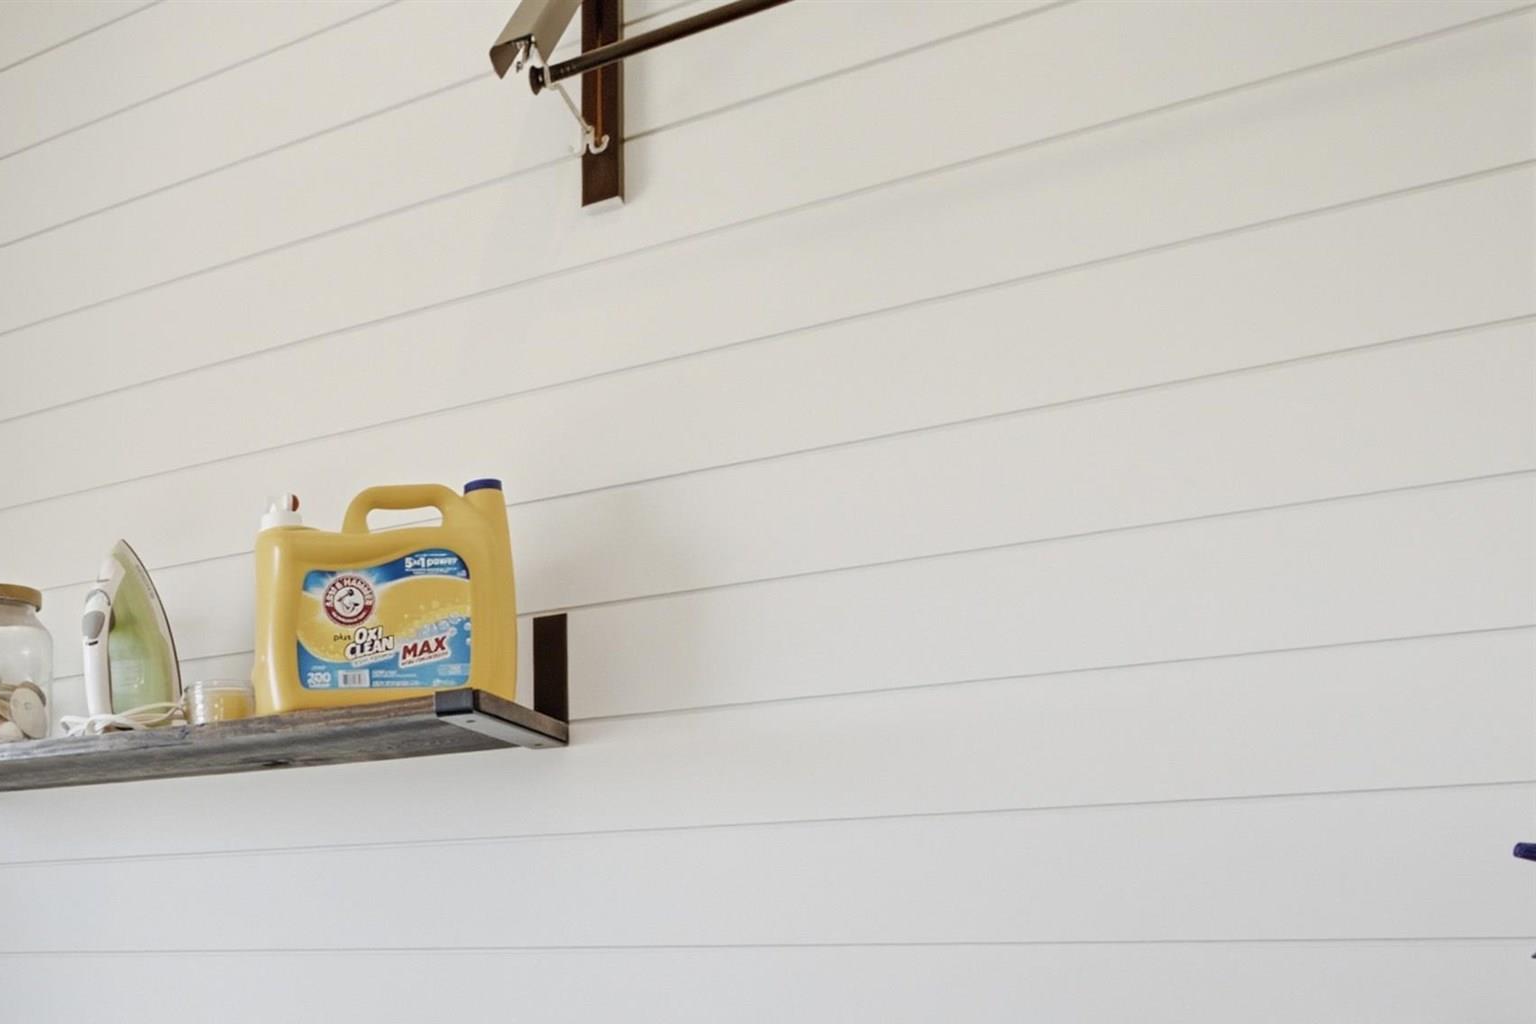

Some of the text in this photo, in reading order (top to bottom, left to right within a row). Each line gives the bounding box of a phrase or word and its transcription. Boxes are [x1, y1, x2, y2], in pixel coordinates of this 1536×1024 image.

[354, 625, 383, 645] OXI
[344, 635, 395, 660] CLEAN
[402, 636, 447, 660] MAX
